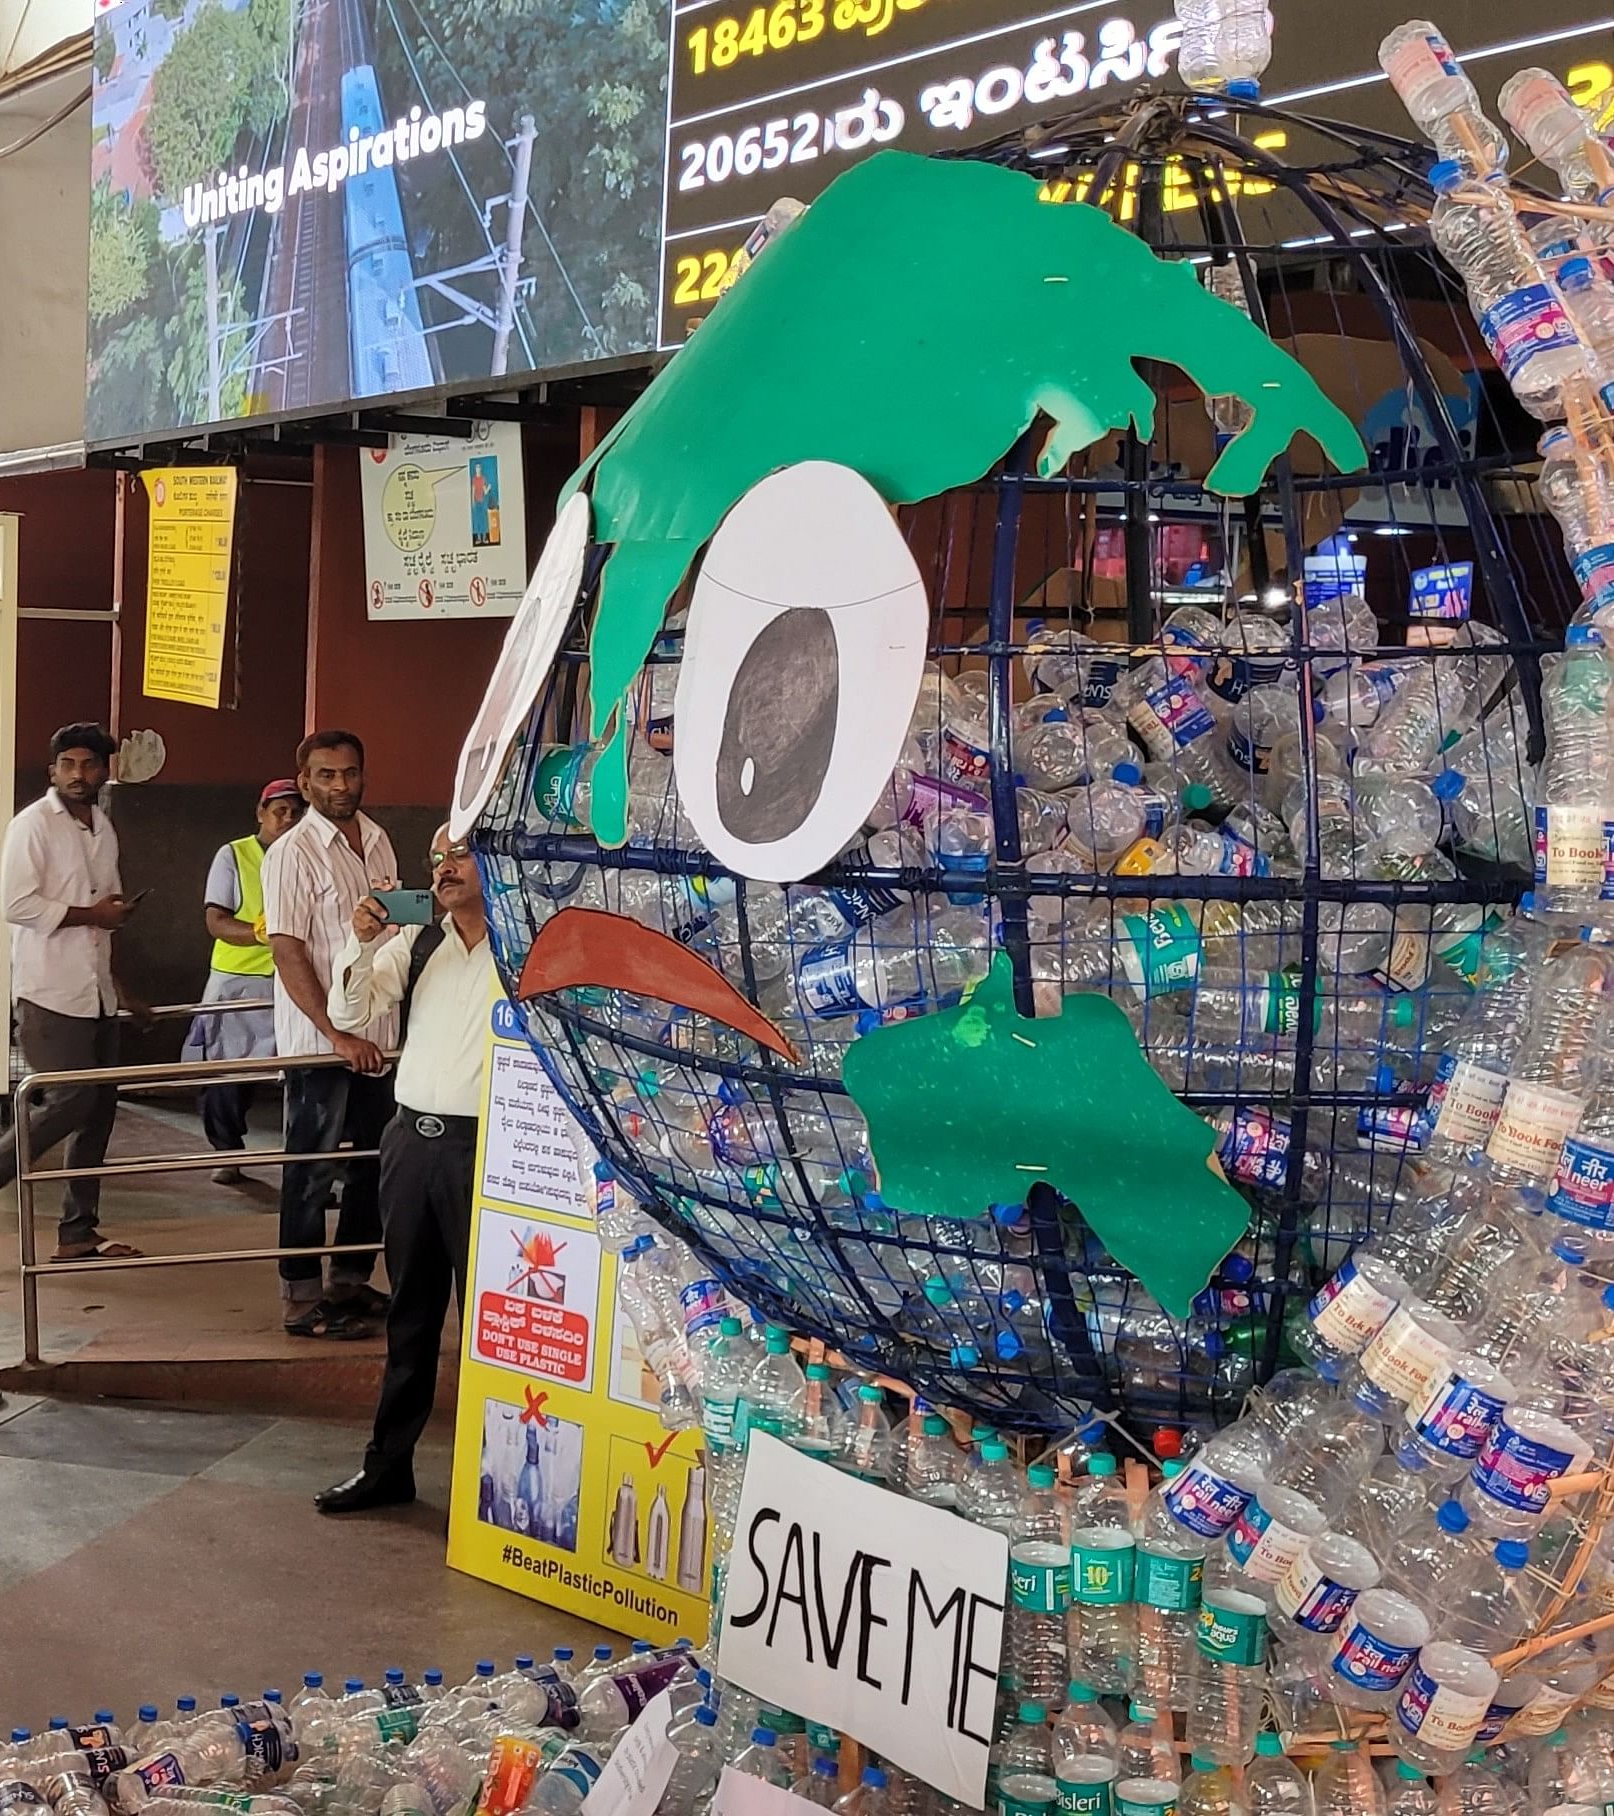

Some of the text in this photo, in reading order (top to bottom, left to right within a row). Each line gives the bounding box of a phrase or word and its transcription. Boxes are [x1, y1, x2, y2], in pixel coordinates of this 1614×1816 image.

[688, 0, 826, 75] 18463
[678, 111, 822, 191] 20652
[183, 100, 486, 227] Uniting Aspirations
[1552, 847, 1604, 859] To Book
[497, 1005, 514, 1028] 16
[1450, 1100, 1463, 1111] To
[1509, 1127, 1542, 1147] Book
[1581, 1158, 1609, 1181] नीर
[1572, 1172, 1608, 1192] neer
[1334, 1302, 1344, 1318] To
[496, 1346, 566, 1375] USE PLASTIC
[517, 1338, 539, 1354] USE
[541, 1344, 582, 1366] SINGLE
[1382, 1345, 1409, 1372] Book
[1192, 1485, 1213, 1503] rail
[1260, 1547, 1273, 1559] To
[502, 1544, 678, 1627] #BeatPlasticPollution
[730, 1508, 1005, 1748] SAVE ME
[1356, 1653, 1379, 1669] rail
[1430, 1714, 1444, 1726] To
